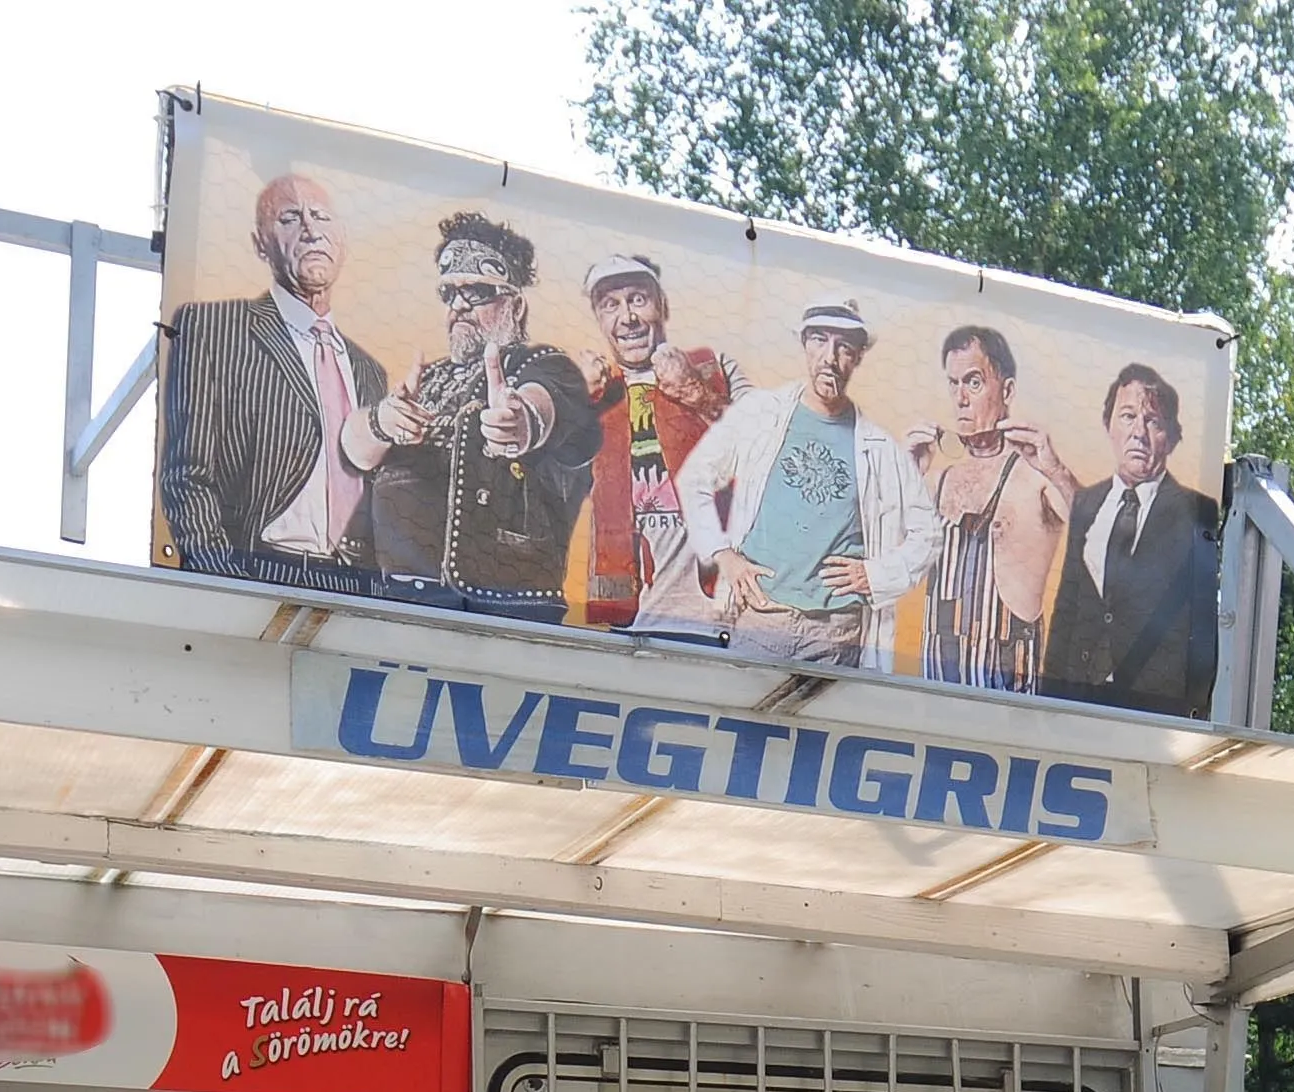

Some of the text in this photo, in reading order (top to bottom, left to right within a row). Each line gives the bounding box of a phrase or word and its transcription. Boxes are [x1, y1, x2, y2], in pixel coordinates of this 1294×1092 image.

[336, 659, 1114, 842] ÜVEGTIGRIS
[240, 986, 382, 1028] Találj rá
[221, 1020, 409, 1080] a Sörömökre!
